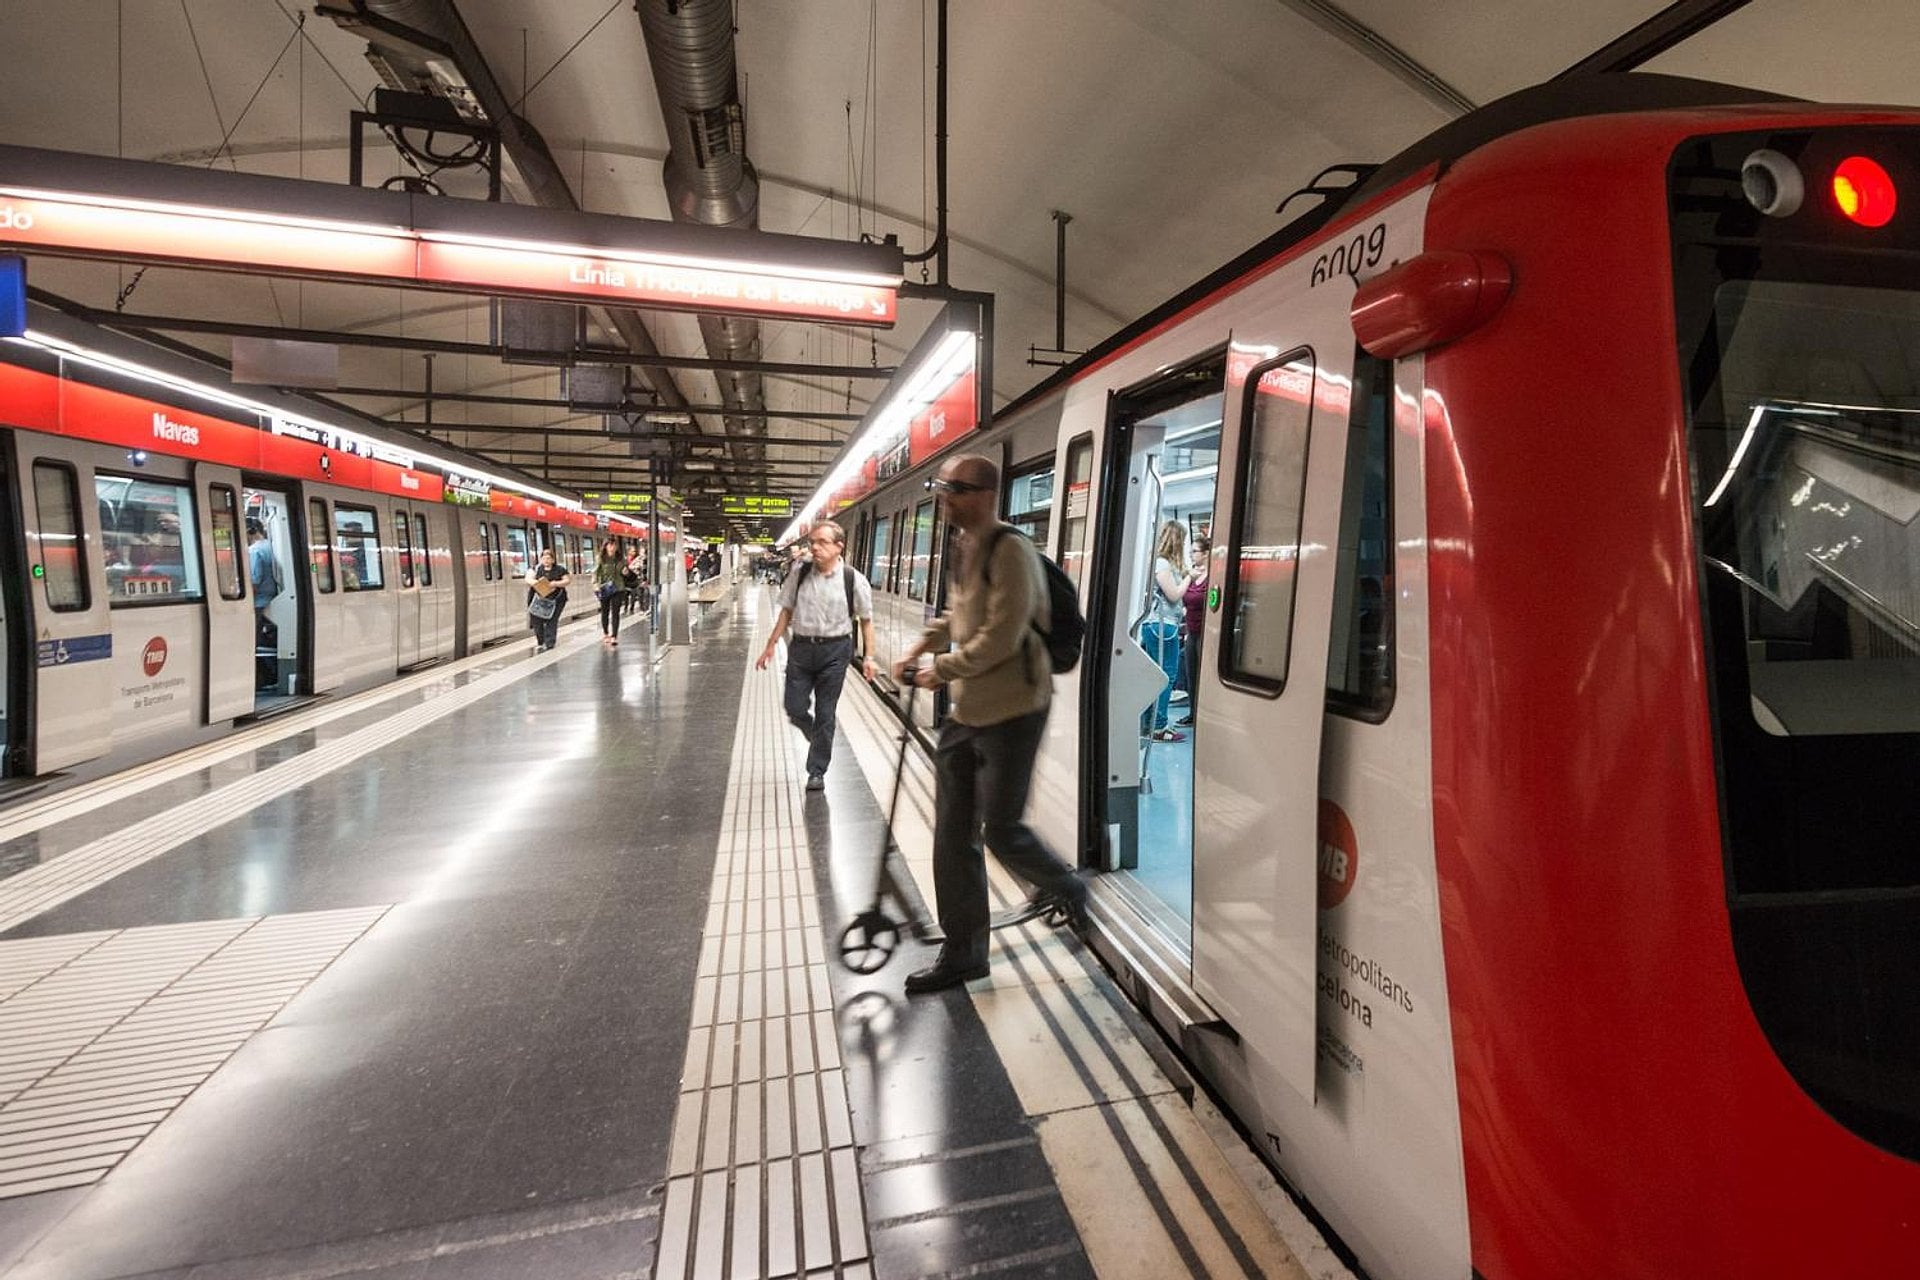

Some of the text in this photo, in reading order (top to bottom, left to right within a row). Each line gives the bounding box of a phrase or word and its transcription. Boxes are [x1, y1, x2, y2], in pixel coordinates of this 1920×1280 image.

[153, 412, 199, 445] Navas
[1320, 845, 1349, 882] MB
[1320, 928, 1413, 1013] etropolitans
[1318, 972, 1372, 1029] celona
